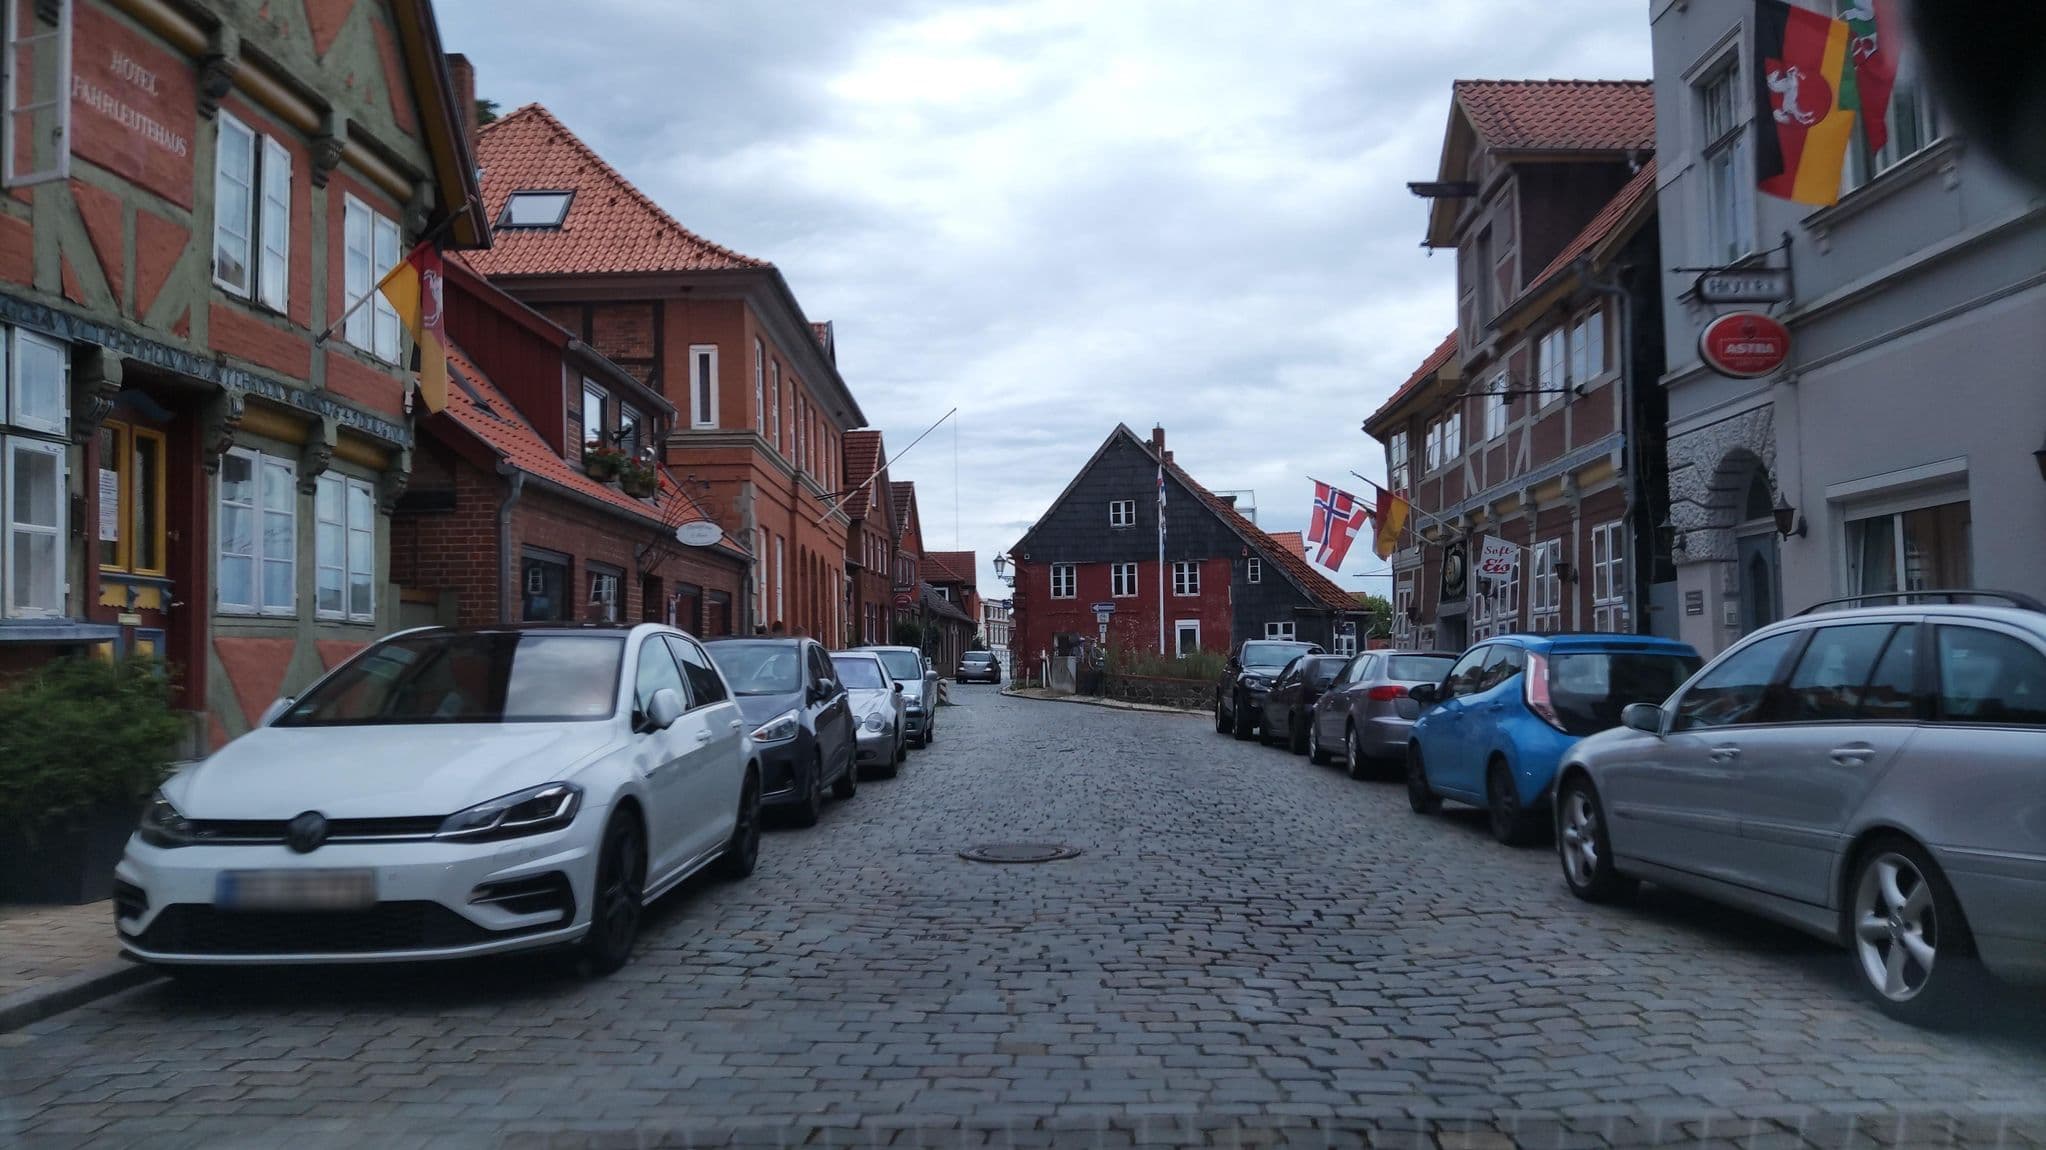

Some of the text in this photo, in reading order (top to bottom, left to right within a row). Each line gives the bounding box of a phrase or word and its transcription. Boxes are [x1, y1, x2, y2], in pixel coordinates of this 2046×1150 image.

[110, 49, 159, 97] HOTEL
[1724, 343, 1775, 354] ASTRA
[1482, 558, 1510, 574] Eis
